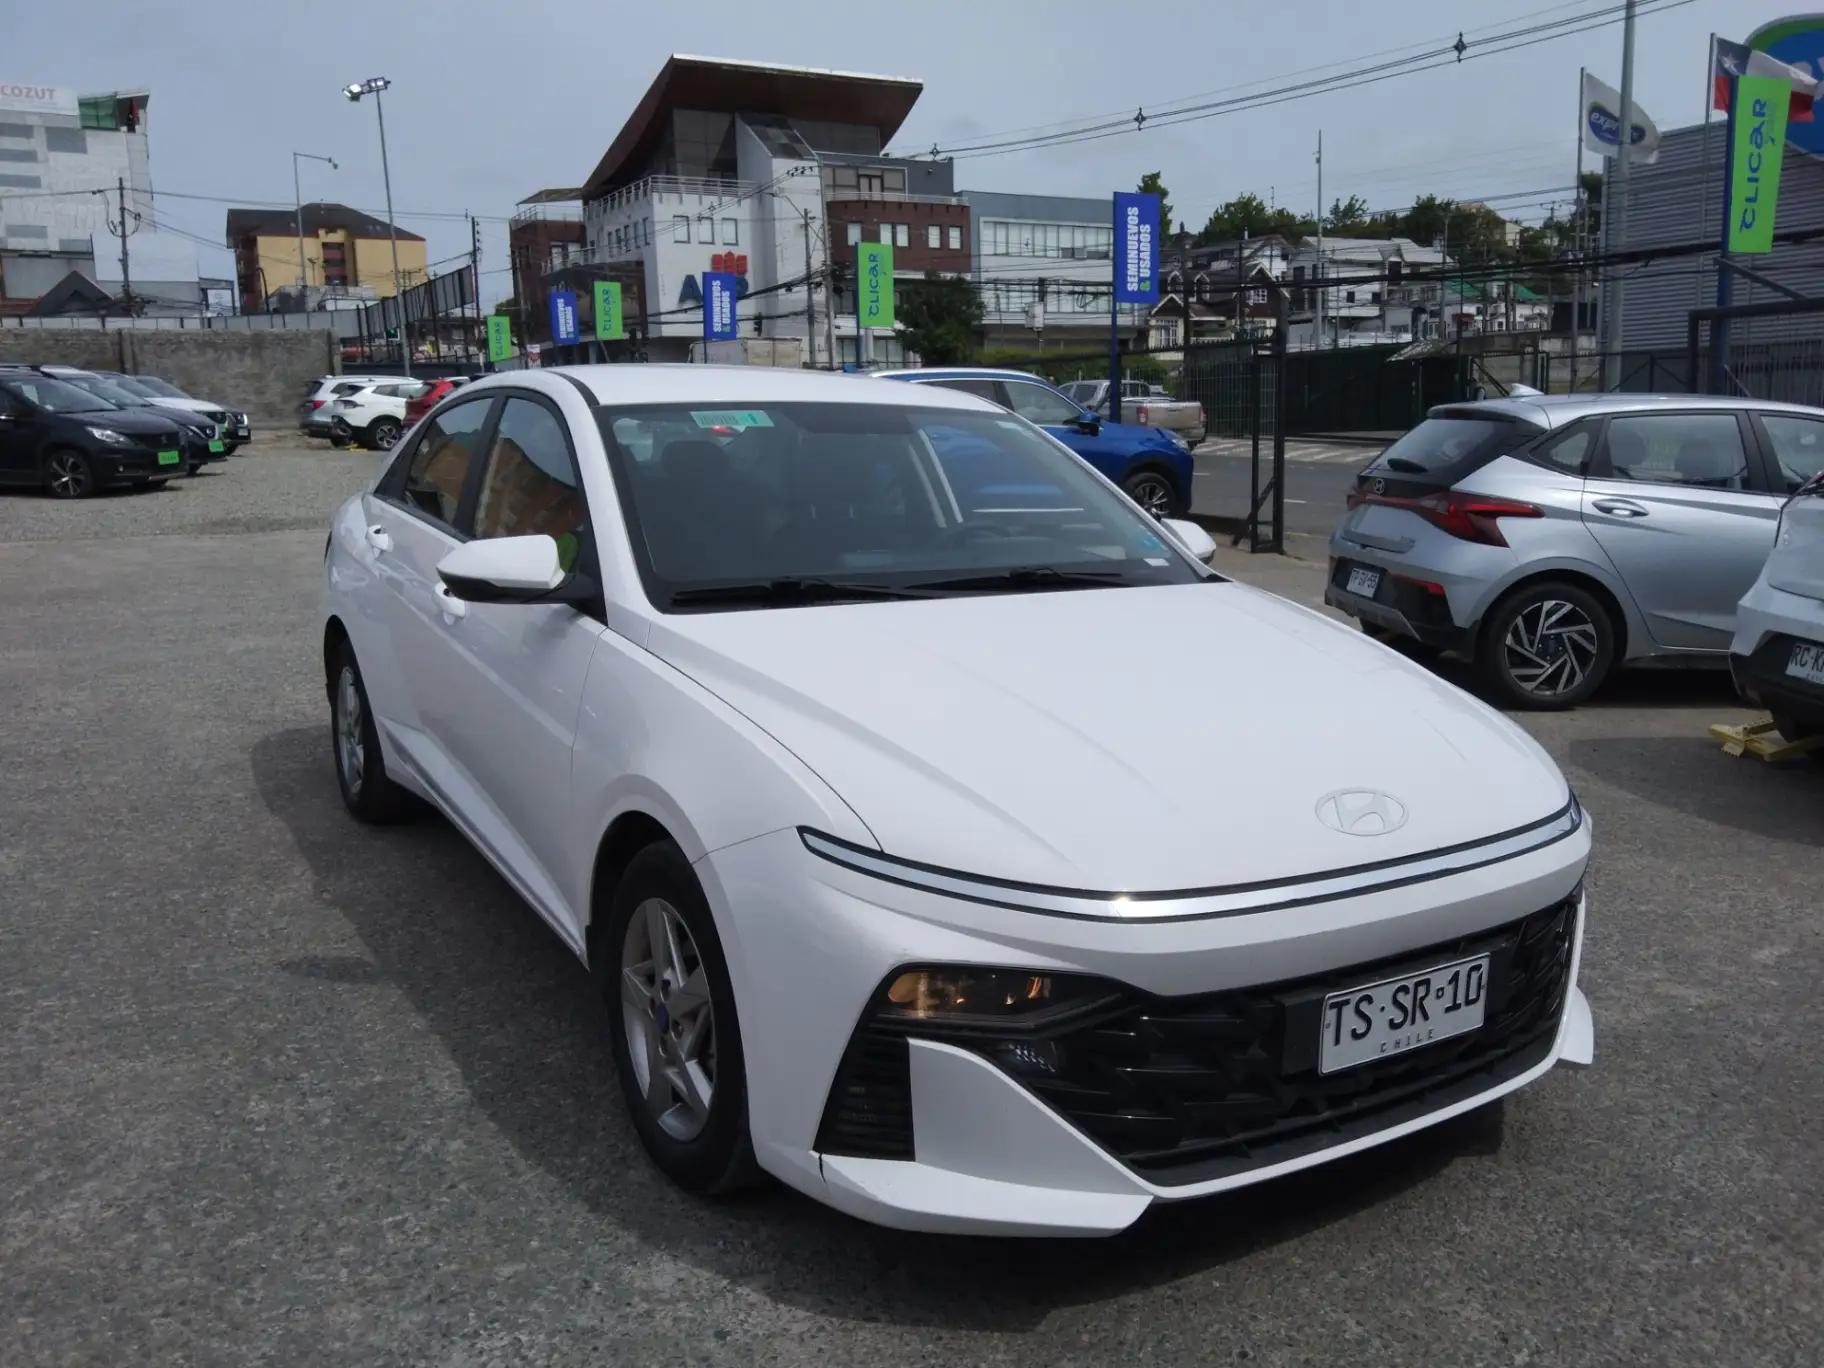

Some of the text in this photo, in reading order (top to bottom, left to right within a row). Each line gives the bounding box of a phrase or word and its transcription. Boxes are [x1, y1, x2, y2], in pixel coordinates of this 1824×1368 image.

[1127, 206, 1139, 292] SEMINUEVOS
[1140, 224, 1151, 278] USADOS
[712, 280, 722, 332] SEMINUEVOS
[722, 291, 731, 324] USADOS
[1380, 1028, 1434, 1053] CHILE
